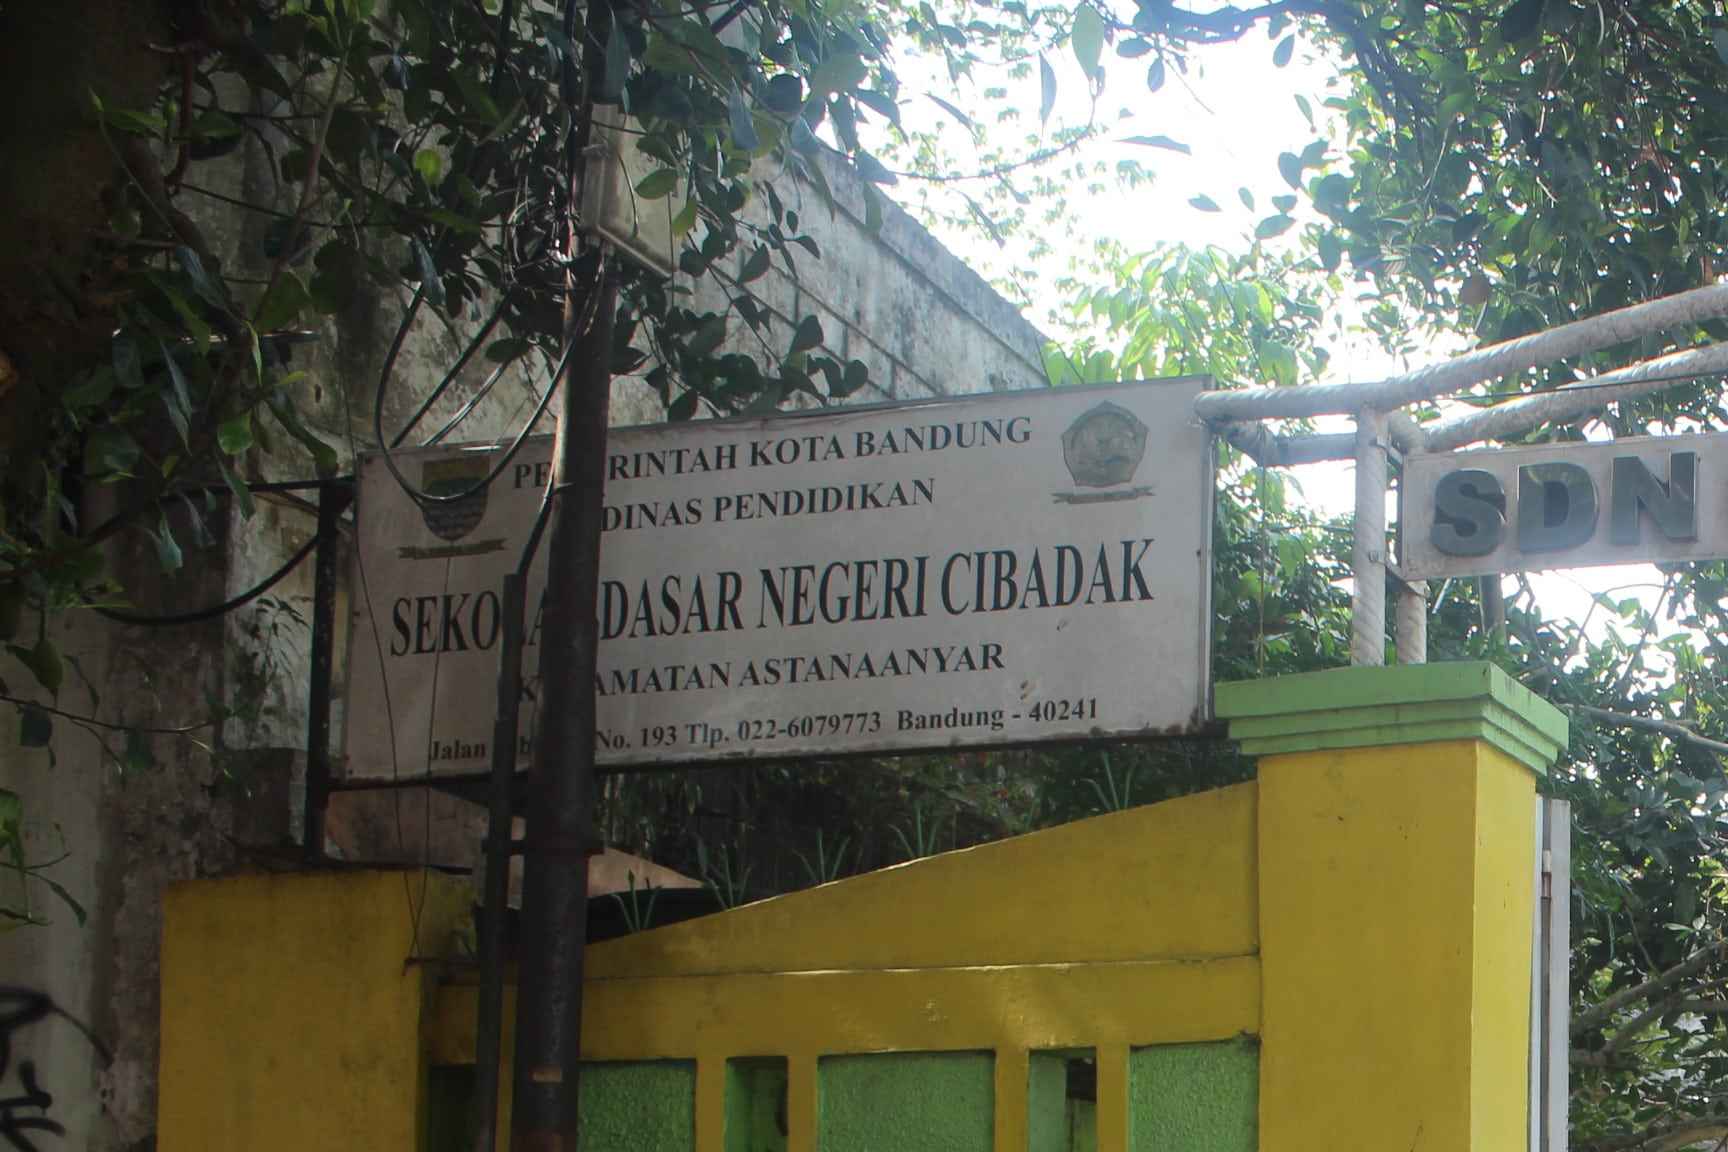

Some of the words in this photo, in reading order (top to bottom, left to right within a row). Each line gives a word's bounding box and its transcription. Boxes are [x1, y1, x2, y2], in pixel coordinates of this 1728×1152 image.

[514, 442, 737, 489] PERINTAH
[749, 434, 846, 468] KOTA
[855, 416, 1033, 458] BANDUNG
[600, 497, 703, 532] DINAS
[713, 478, 936, 523] PENDIDIKAN
[1429, 451, 1699, 558] SDN
[600, 570, 744, 641] DASAR
[757, 554, 930, 630] NEGERI
[940, 537, 1155, 617] CIBADAK
[737, 642, 1005, 688] ASTANAANYAR
[428, 739, 487, 762] Jalan
[640, 724, 678, 747] 193
[685, 722, 731, 746] Tlp.
[737, 711, 882, 743] 022-6079773
[896, 707, 1005, 732] Bandung
[1028, 697, 1098, 722] 40241
